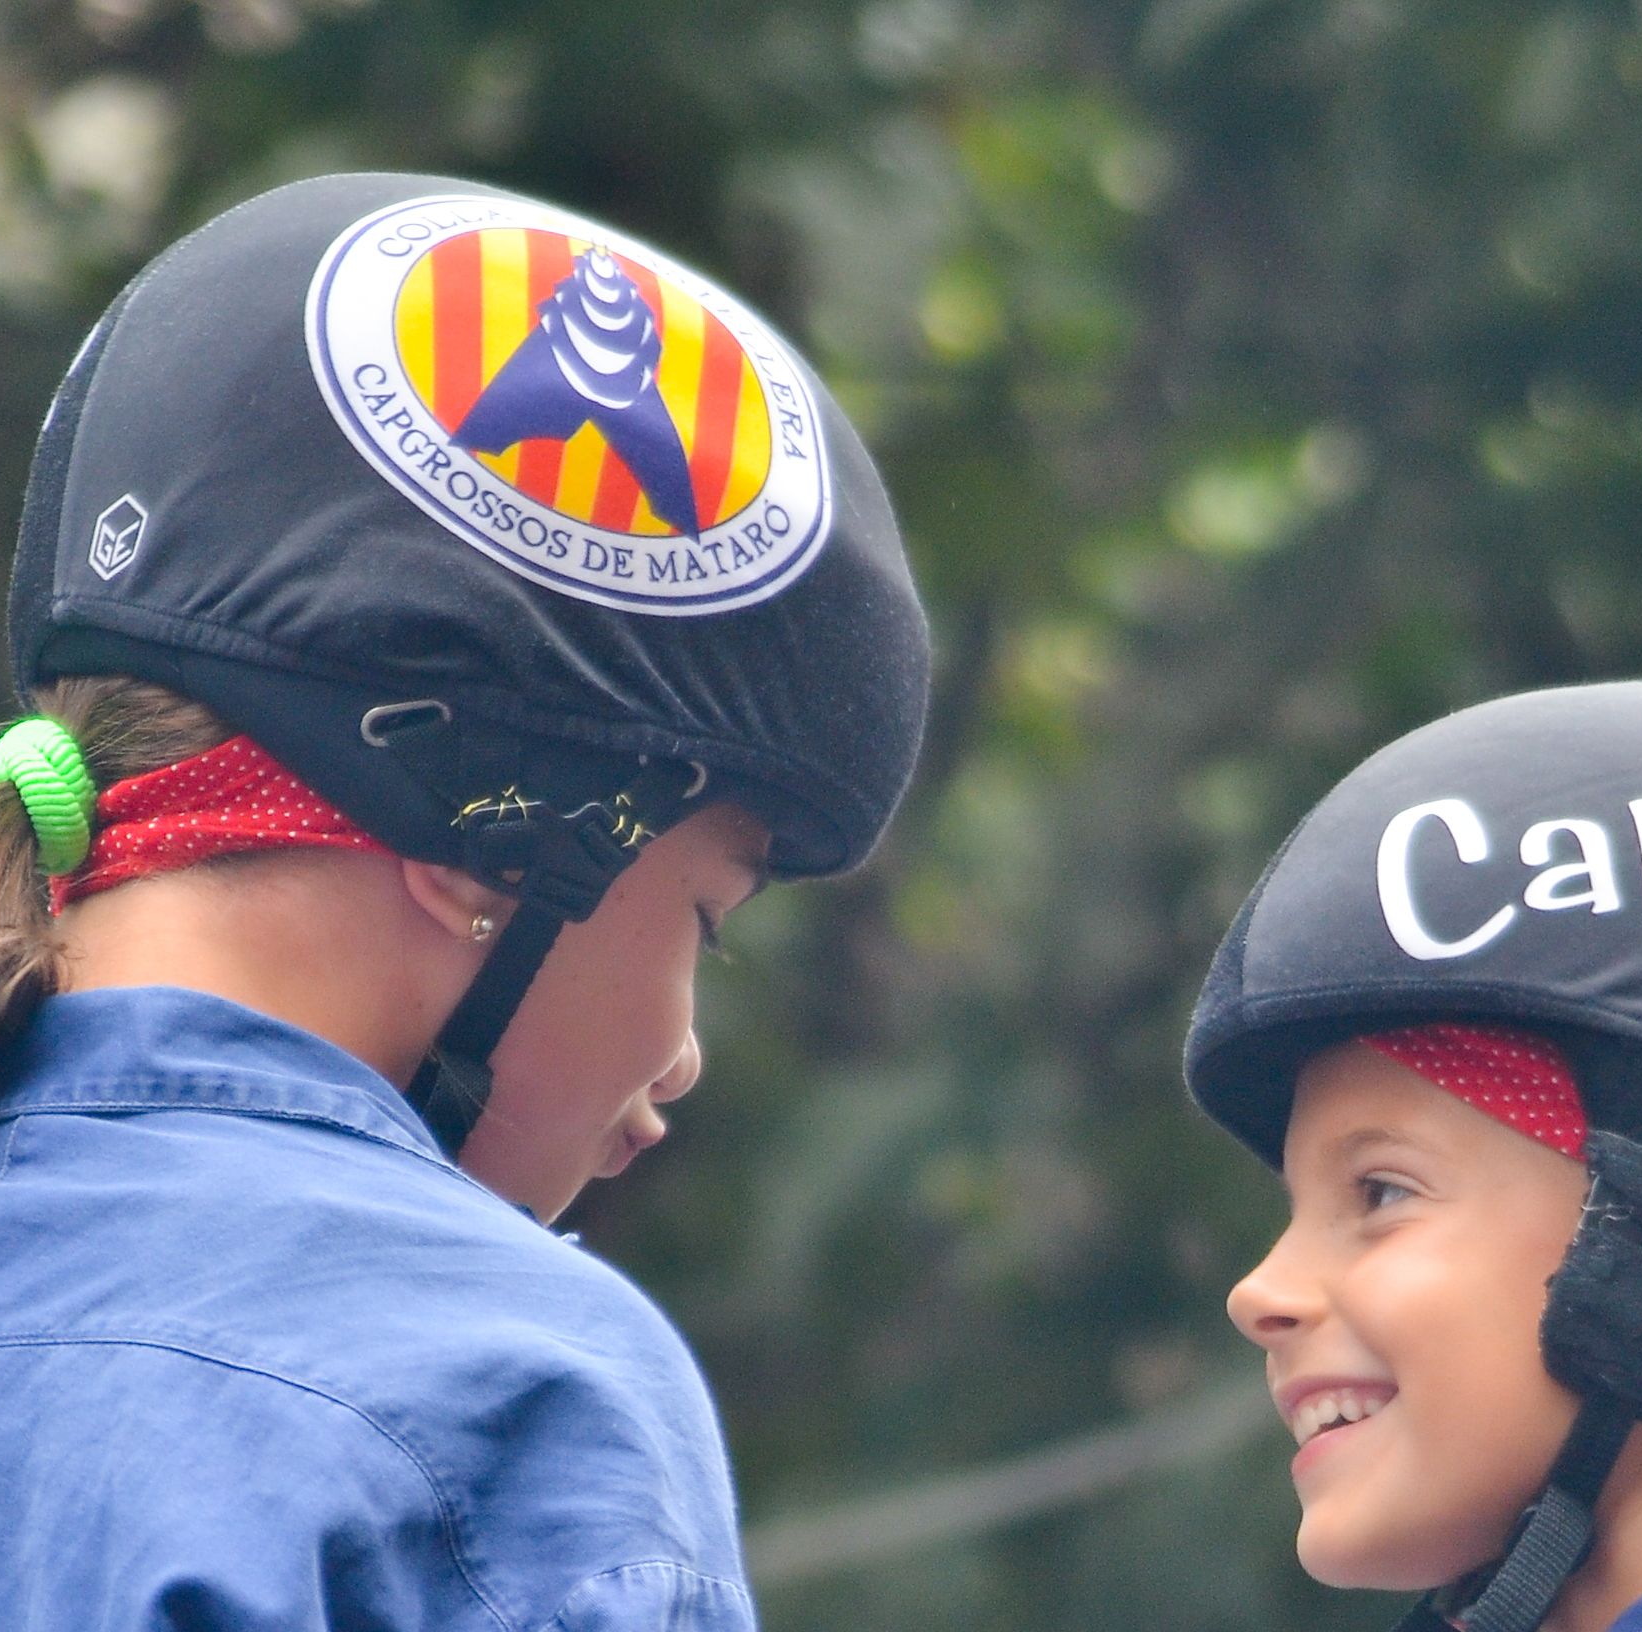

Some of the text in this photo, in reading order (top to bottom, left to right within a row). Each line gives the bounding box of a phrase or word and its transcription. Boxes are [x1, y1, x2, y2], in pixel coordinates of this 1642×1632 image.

[353, 363, 791, 584] CAPGROSSOS DE MATARÓ
